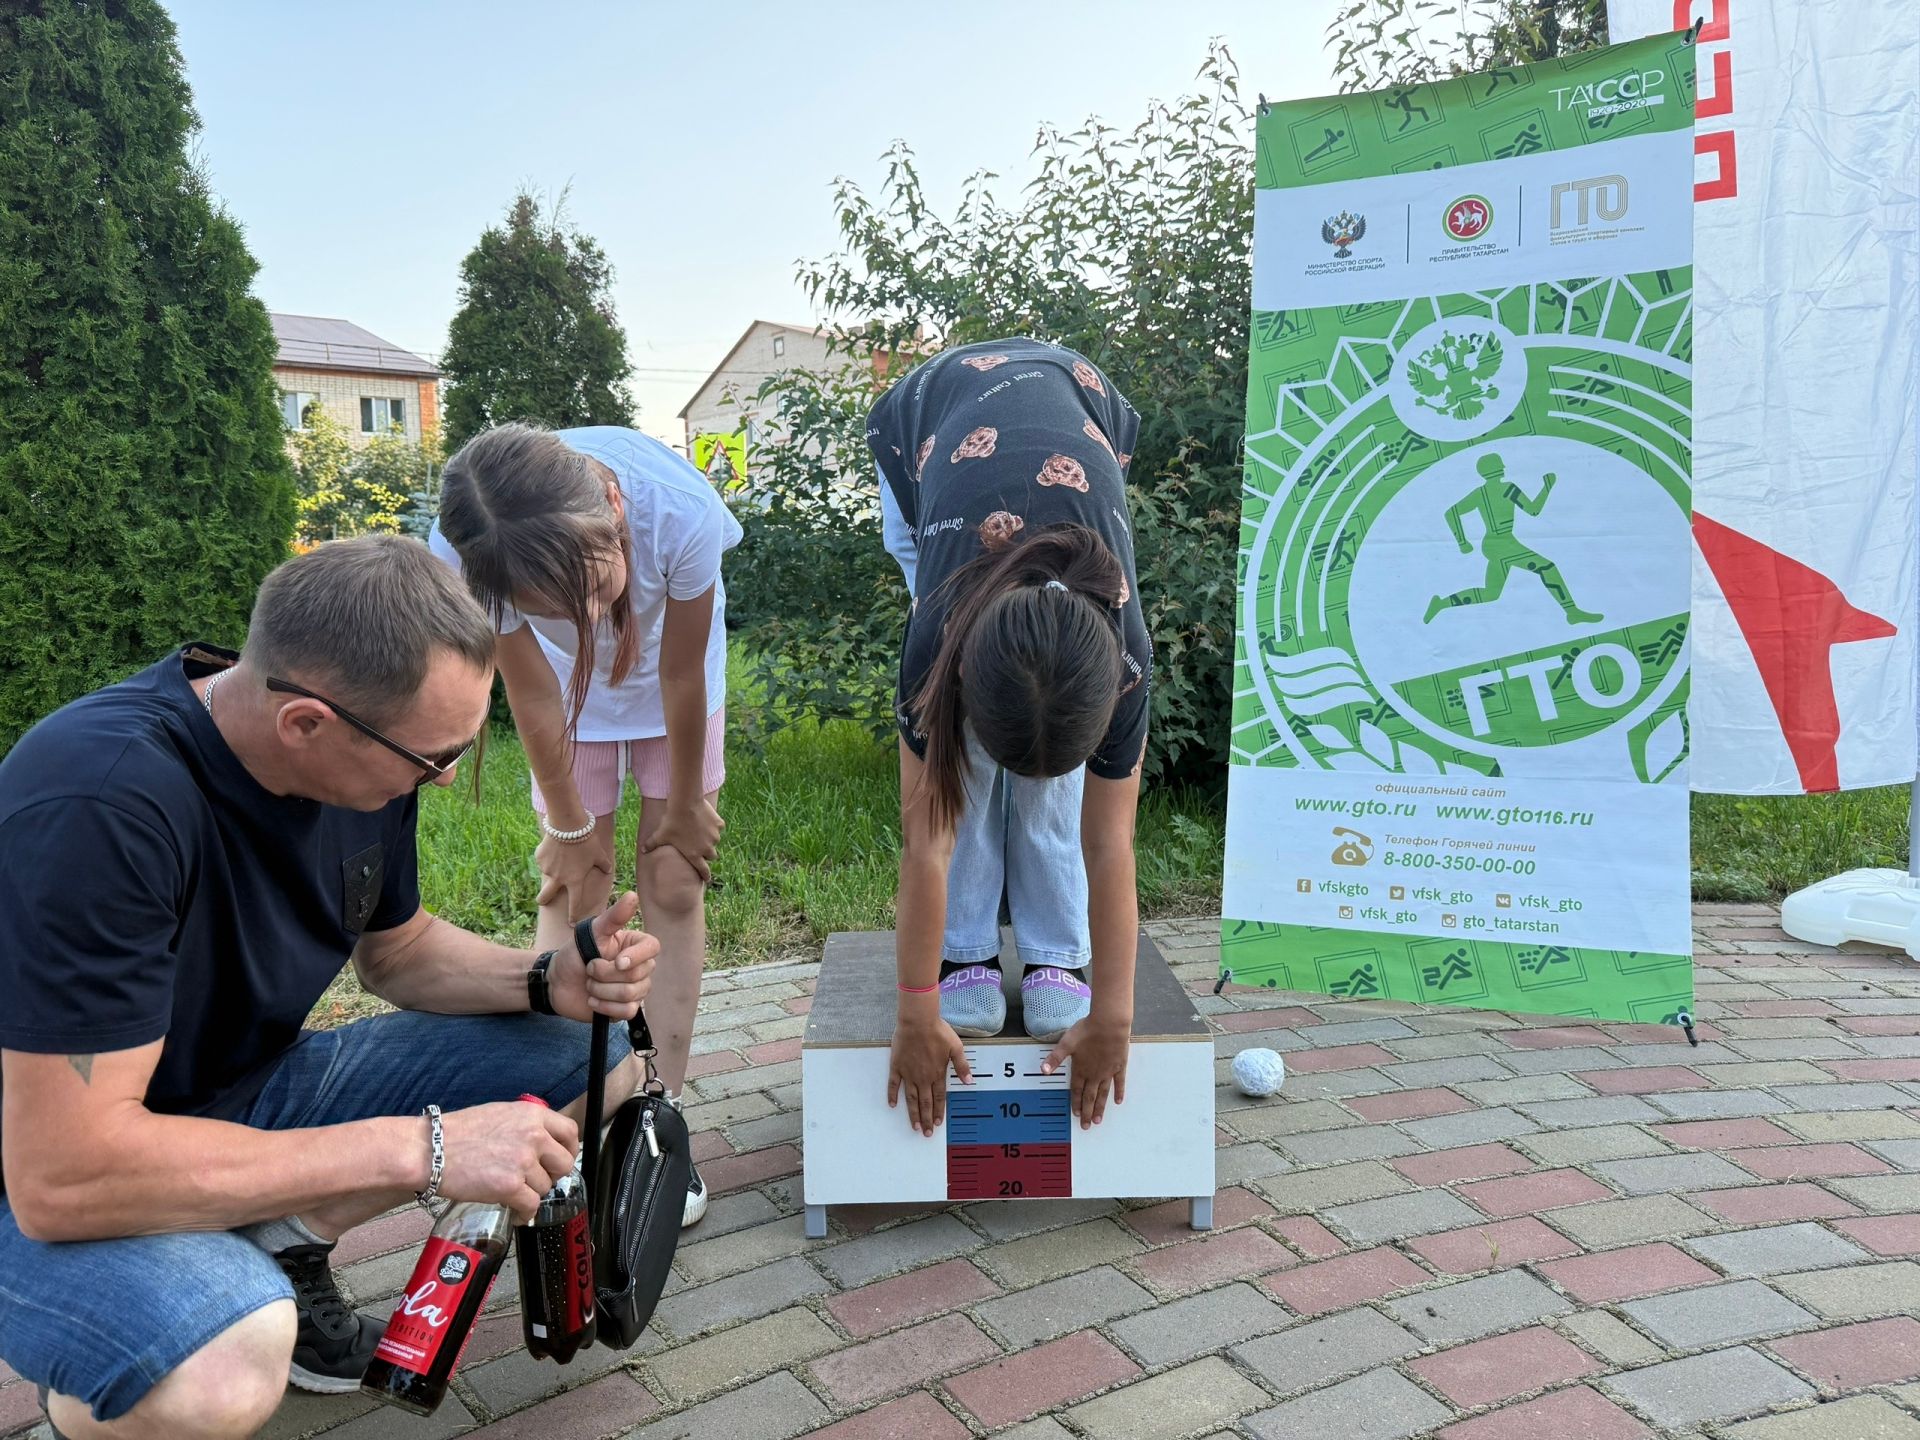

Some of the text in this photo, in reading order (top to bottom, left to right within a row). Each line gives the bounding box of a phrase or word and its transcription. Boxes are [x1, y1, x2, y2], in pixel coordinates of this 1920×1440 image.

[1589, 99, 1647, 117] 1920-2020
[1550, 174, 1629, 229] ГТО
[1429, 248, 1509, 263] РЕСПУБЛИКИ ТАТАРСТАН
[1442, 243, 1496, 255] ПРАВИТЕЛЬСТВО
[1304, 263, 1386, 276] РОССИЙСКОЙ ФЕДЕРАЦИИ
[1307, 257, 1383, 270] МИНИСТЕРСТВО СПОРТА
[977, 381, 1011, 403] Culture
[1459, 642, 1642, 737] ГТО
[1375, 782, 1507, 799] официальный сайт
[1294, 797, 1595, 827] www.gto.ru www.gto116.ru
[1384, 834, 1536, 853] Телефон Горячей линии
[1383, 851, 1536, 876] 8-800-350-00-00
[1317, 880, 1370, 899] vfskgto
[1411, 886, 1474, 906] vfsk_gto
[1518, 893, 1583, 913] vfsk_gto
[1359, 905, 1418, 925] vfsk_gto
[1463, 914, 1560, 934] gto_tatarstan
[1003, 1062, 1015, 1078] 5
[999, 1102, 1021, 1119] 10
[1000, 1143, 1021, 1159] 15
[998, 1180, 1023, 1196] 20
[574, 1231, 589, 1290] COLA
